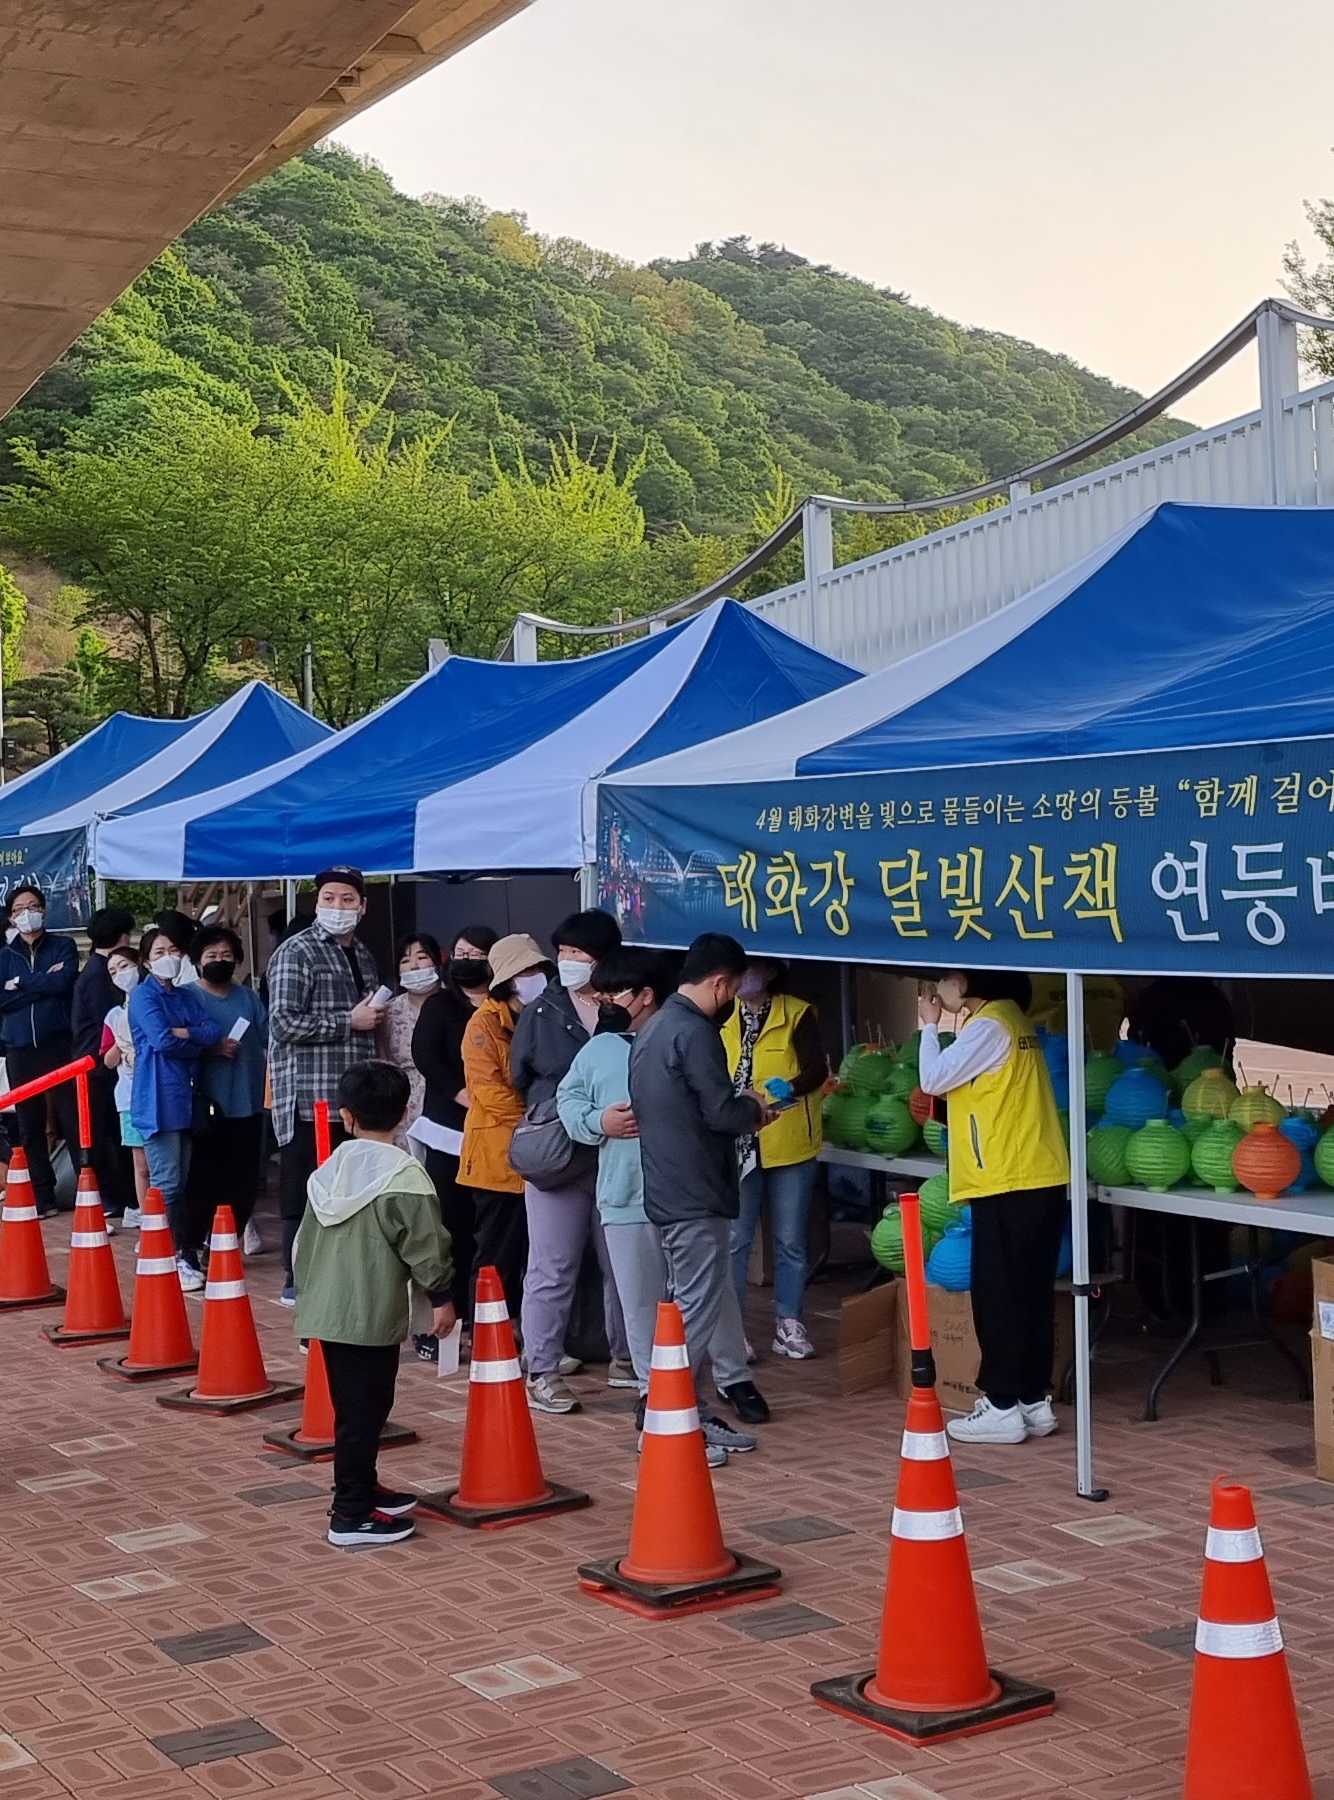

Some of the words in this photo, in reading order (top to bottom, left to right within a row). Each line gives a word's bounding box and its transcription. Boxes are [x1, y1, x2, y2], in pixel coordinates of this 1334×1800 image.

[755, 806, 784, 833] 4월
[787, 801, 875, 832] 태화강변을
[879, 799, 936, 829] 빛으로
[940, 793, 1026, 826] 물들이는
[1031, 787, 1101, 821] 소망의
[1107, 784, 1160, 818] 등불
[716, 849, 856, 937] 태화강
[877, 841, 1124, 944] 달빛산책
